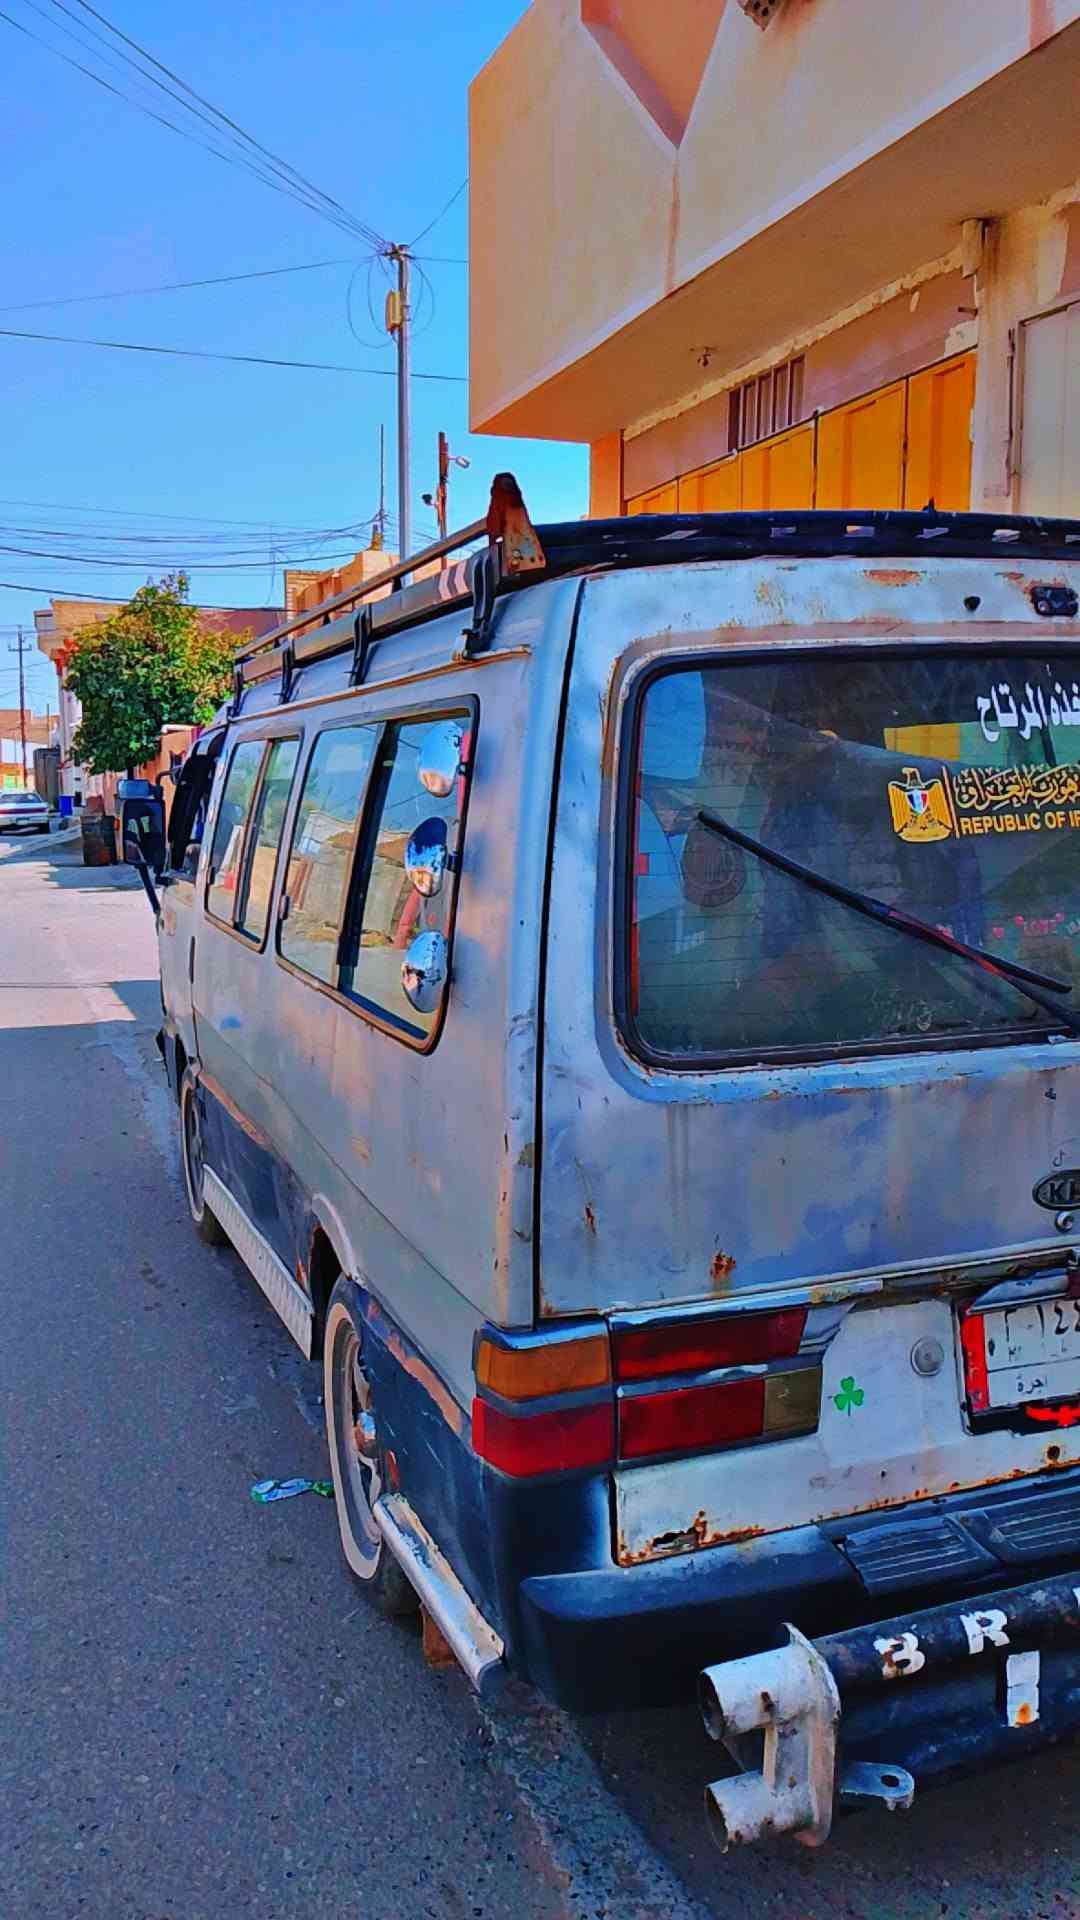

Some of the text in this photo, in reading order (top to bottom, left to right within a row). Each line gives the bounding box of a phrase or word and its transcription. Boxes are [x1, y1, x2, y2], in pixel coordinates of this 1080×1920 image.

[977, 682, 1048, 742] المرتاح
[960, 812, 1041, 835] REPUBLIC
[1045, 811, 1066, 829] OF
